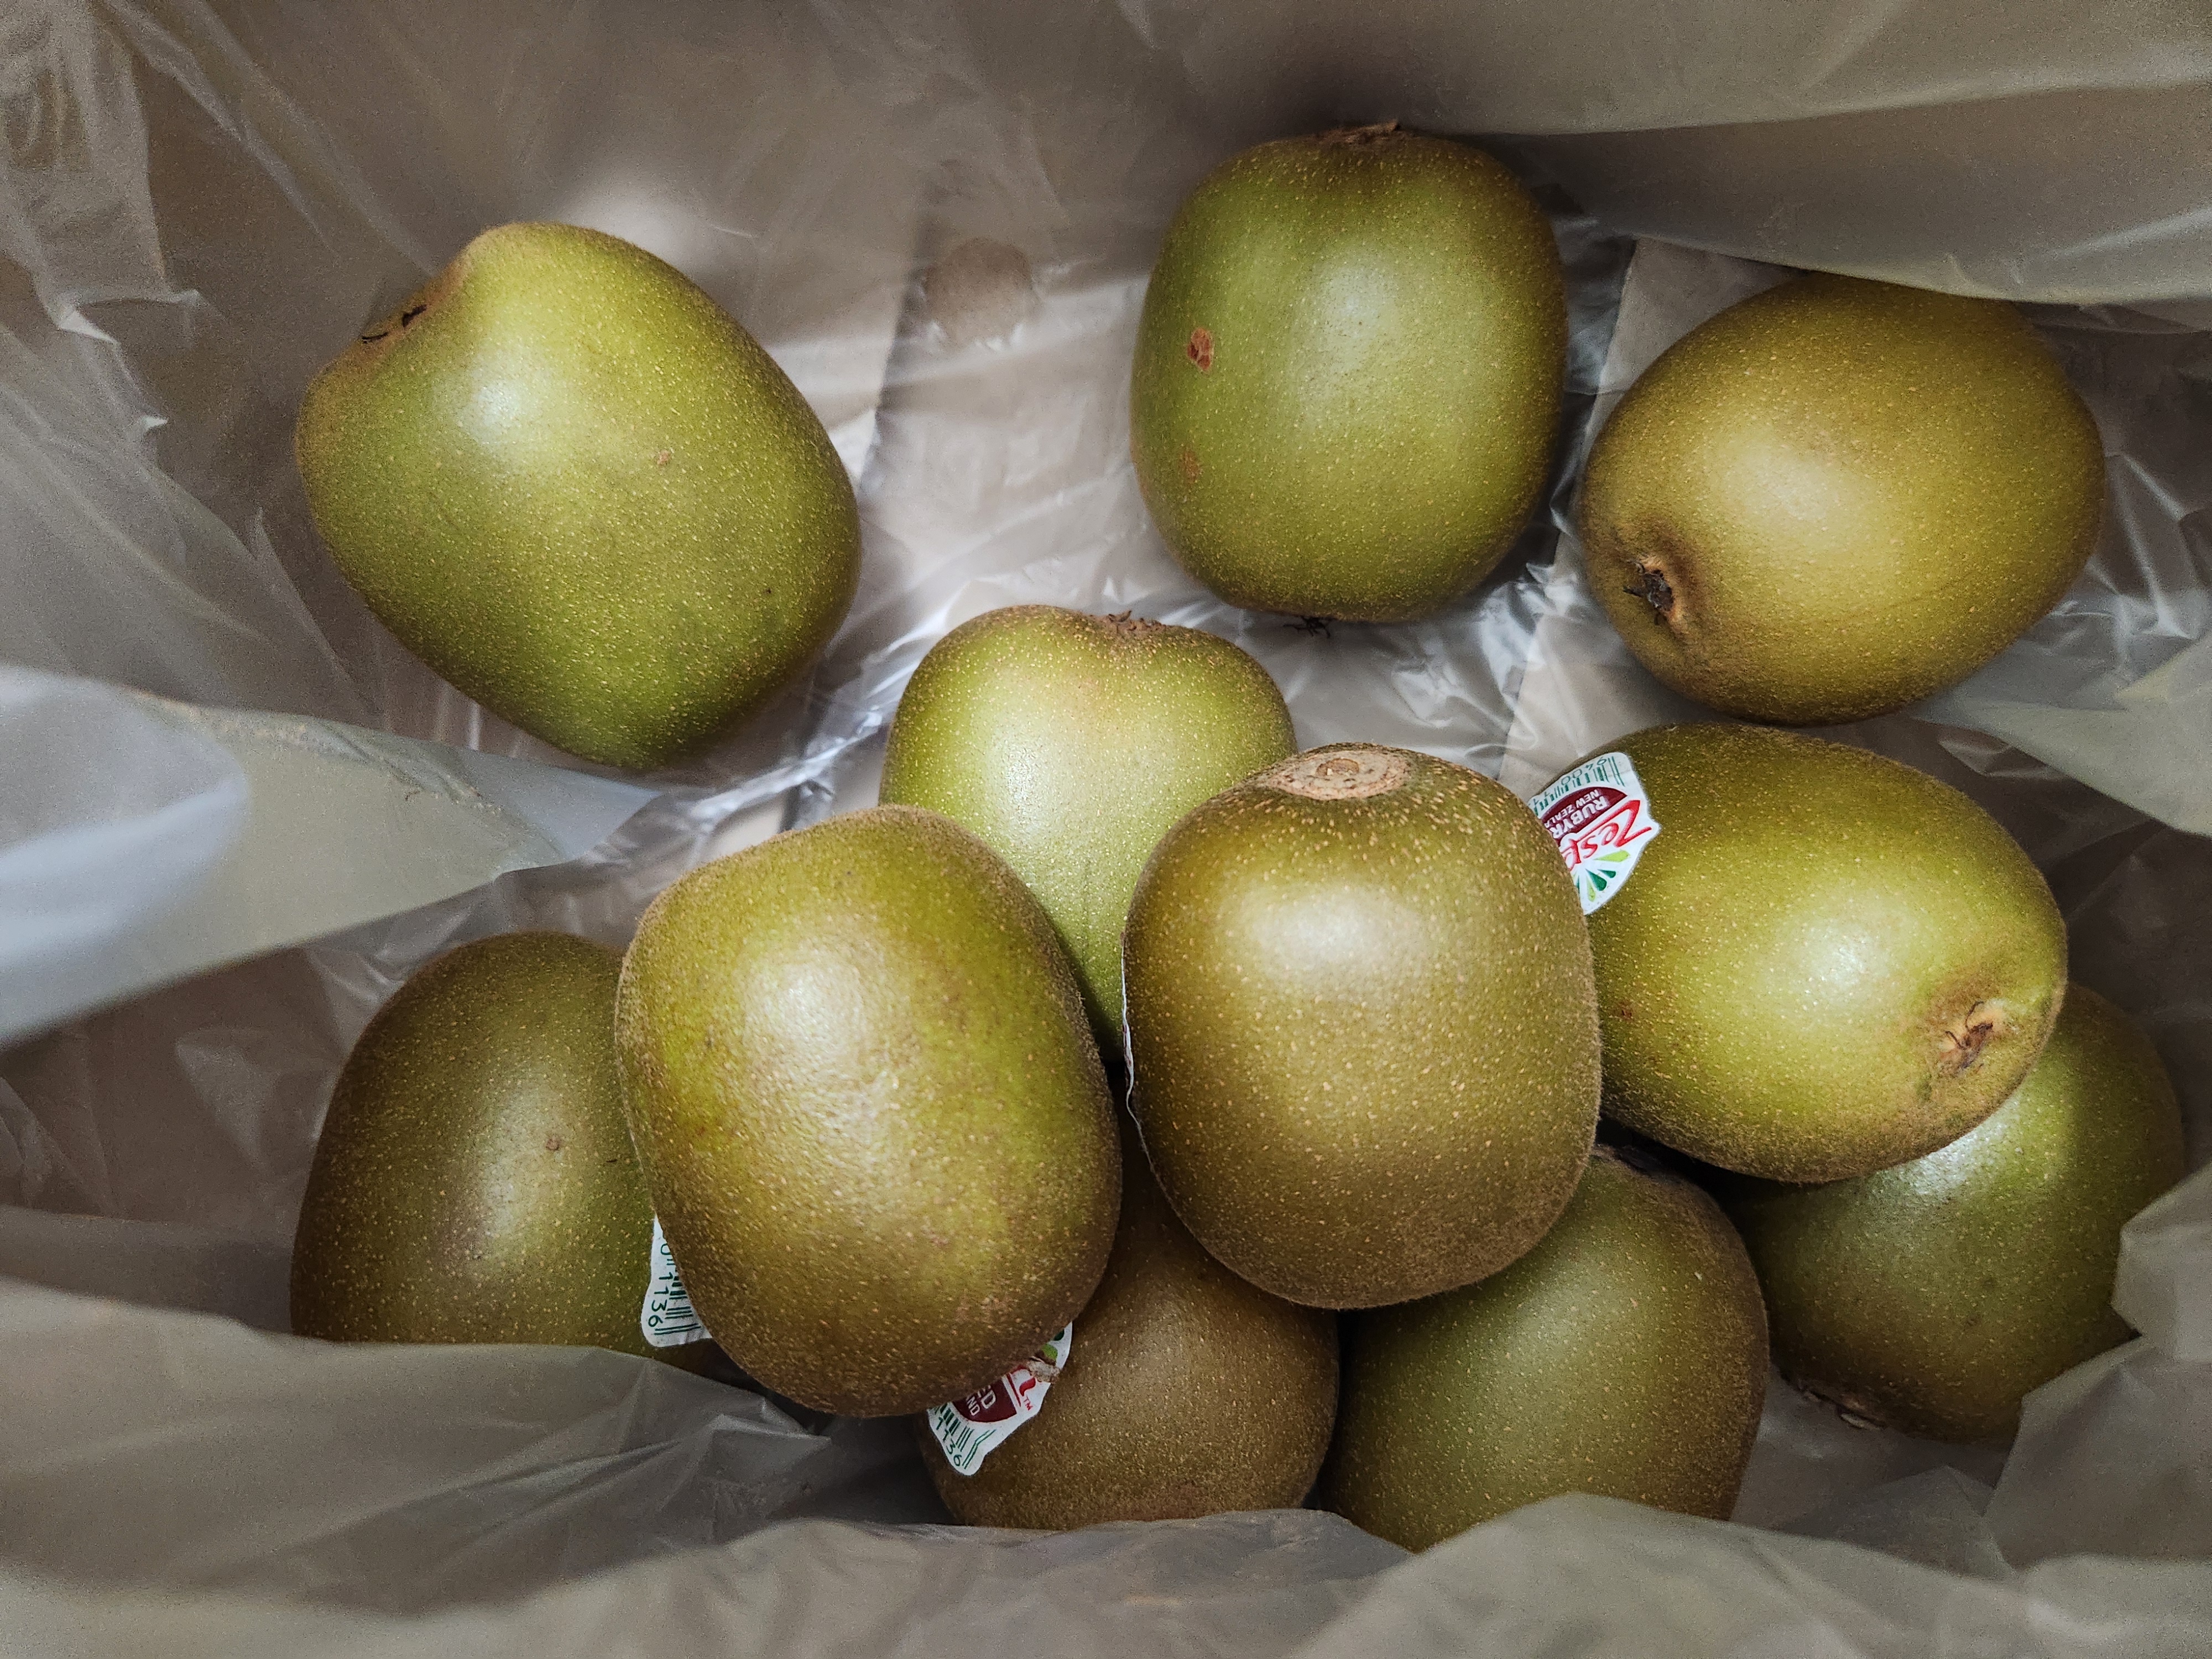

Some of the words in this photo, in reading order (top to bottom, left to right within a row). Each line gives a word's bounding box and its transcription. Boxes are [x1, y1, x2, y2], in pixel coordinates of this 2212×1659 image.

[1561, 758, 1607, 785] 9400
[1575, 789, 1600, 809] NEW
[648, 1271, 674, 1327] 1136
[935, 1416, 962, 1467] 1136
